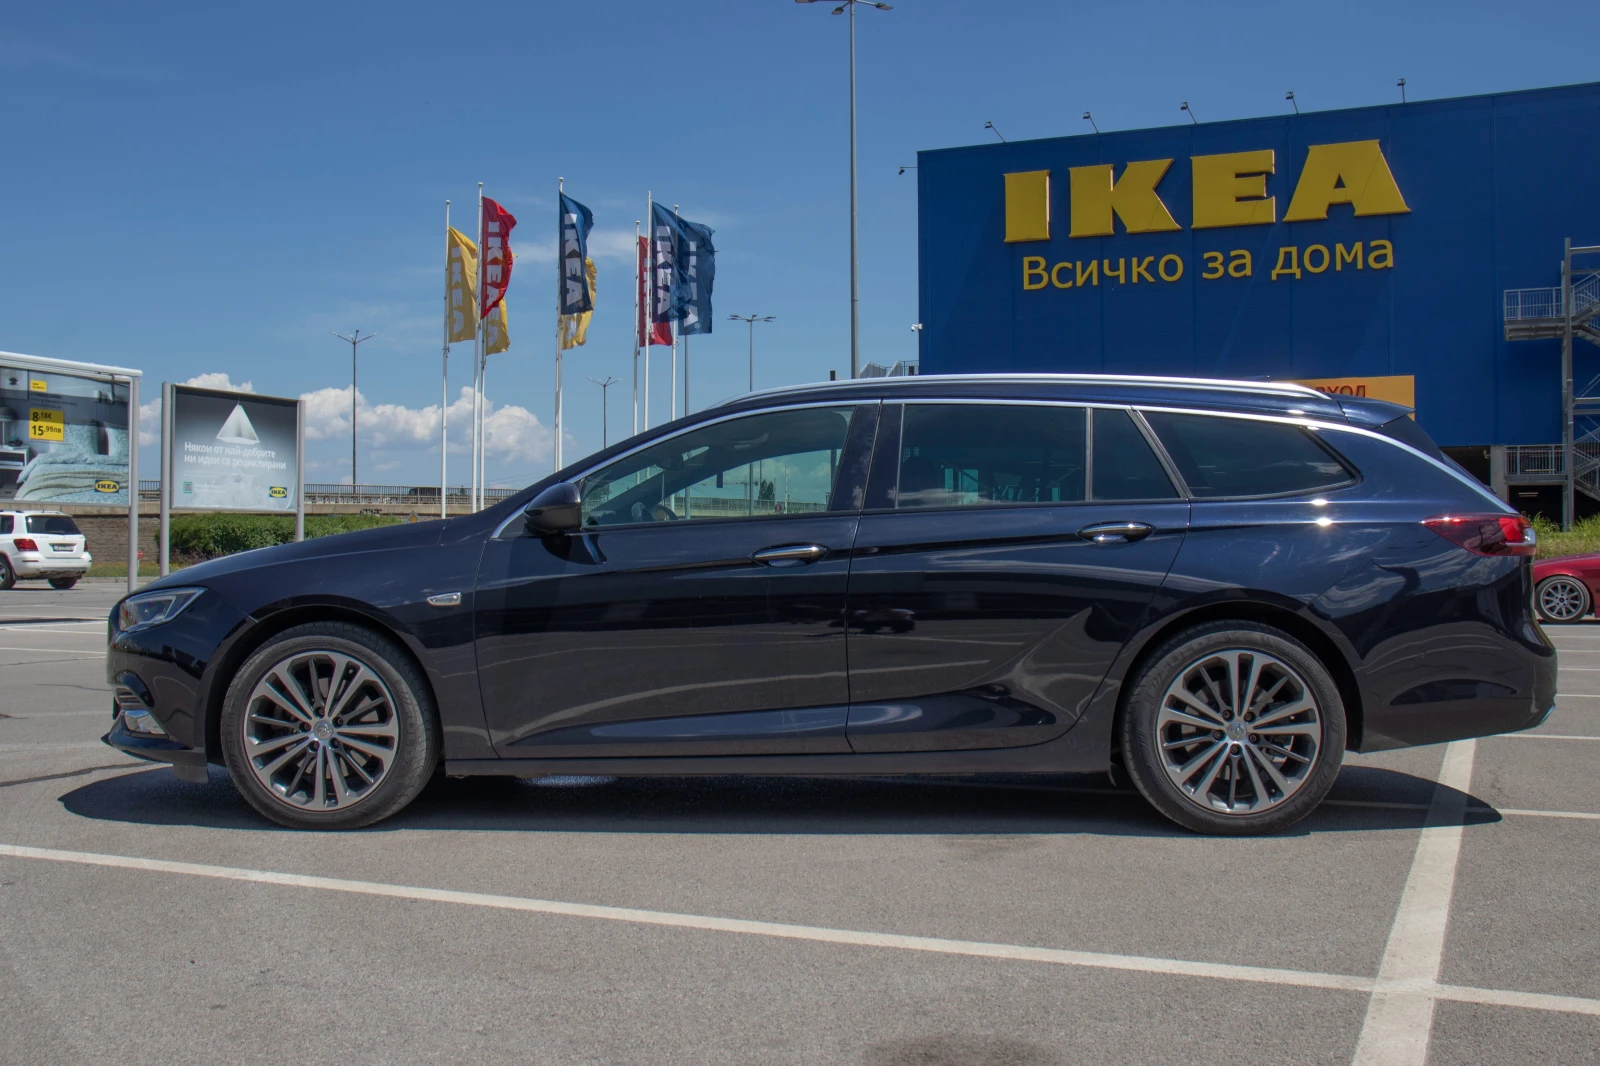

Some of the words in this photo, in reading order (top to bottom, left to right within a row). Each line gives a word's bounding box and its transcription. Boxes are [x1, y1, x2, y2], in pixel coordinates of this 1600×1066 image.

[1003, 139, 1411, 243] IKEA
[452, 246, 464, 334] IKEA
[486, 221, 503, 309] IKEA
[564, 213, 583, 306] IKEA
[657, 226, 672, 315] IKEA
[1022, 253, 1184, 291] Всичко
[1202, 249, 1253, 280] за
[1271, 239, 1394, 281] дома
[184, 442, 212, 452] Някои
[225, 445, 276, 459] най-добрите
[198, 456, 220, 465] идеи
[232, 459, 286, 470] рециклирани
